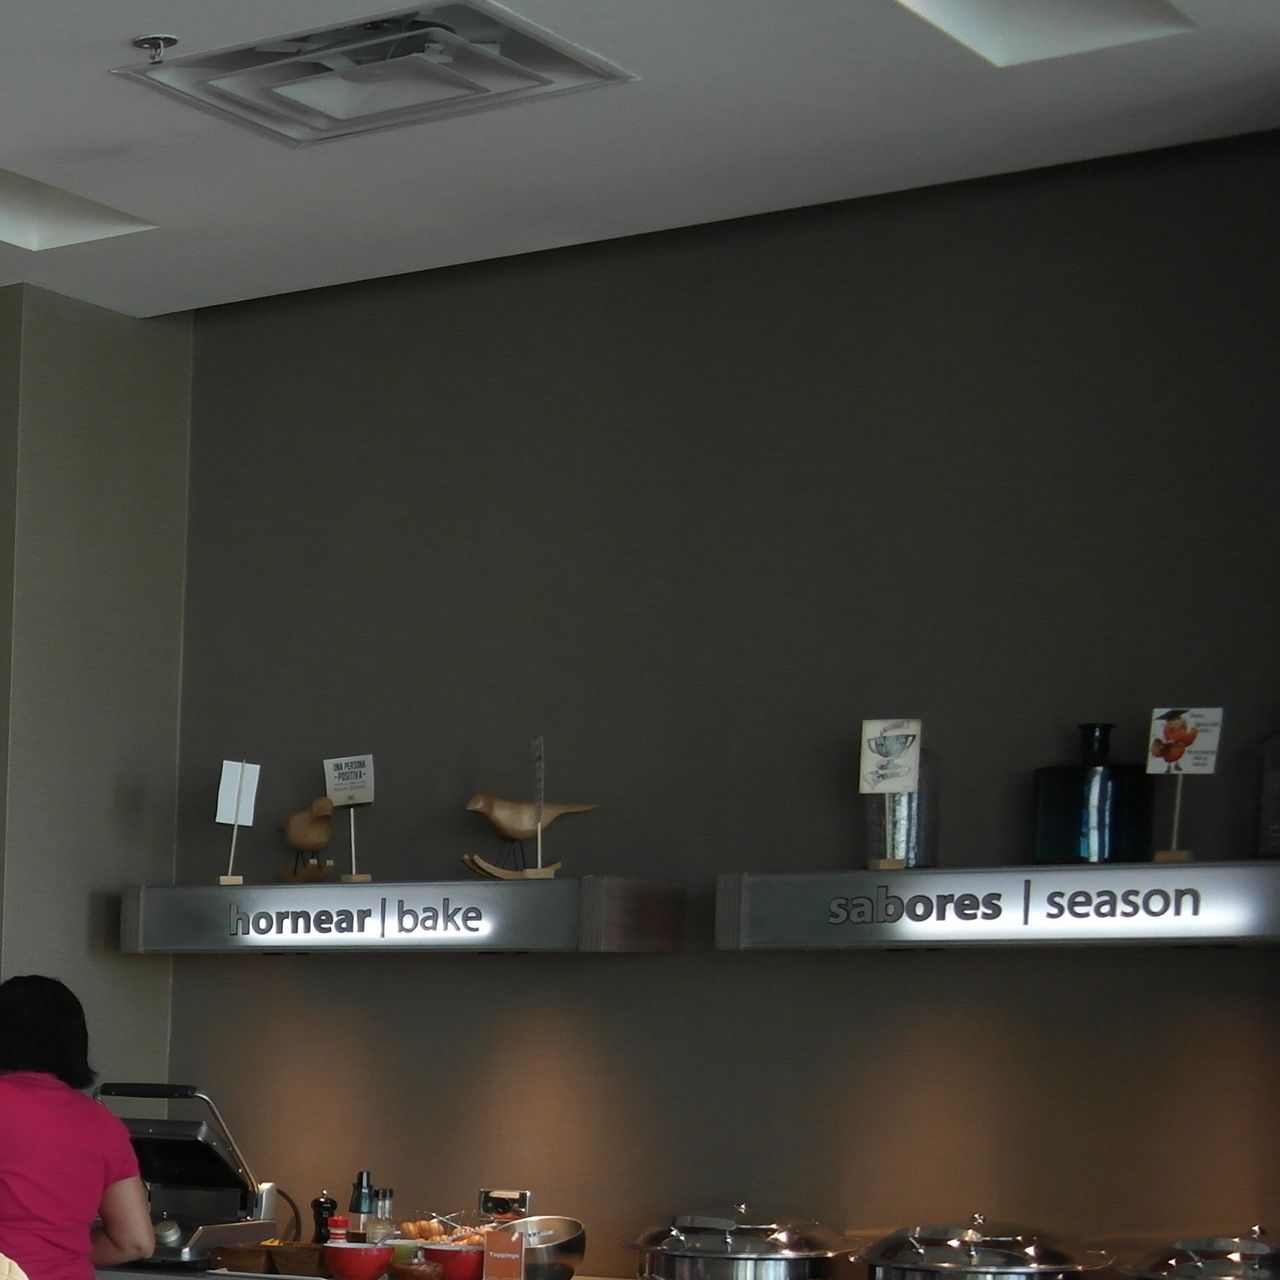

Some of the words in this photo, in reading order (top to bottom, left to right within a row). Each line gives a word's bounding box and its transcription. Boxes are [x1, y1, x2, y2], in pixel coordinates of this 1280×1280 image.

[344, 760, 366, 770] PERSONA
[228, 903, 372, 936] hornear
[397, 897, 484, 933] bake
[827, 885, 1002, 925] sabores
[1045, 886, 1201, 920] season
[489, 1251, 519, 1260] Toppings
